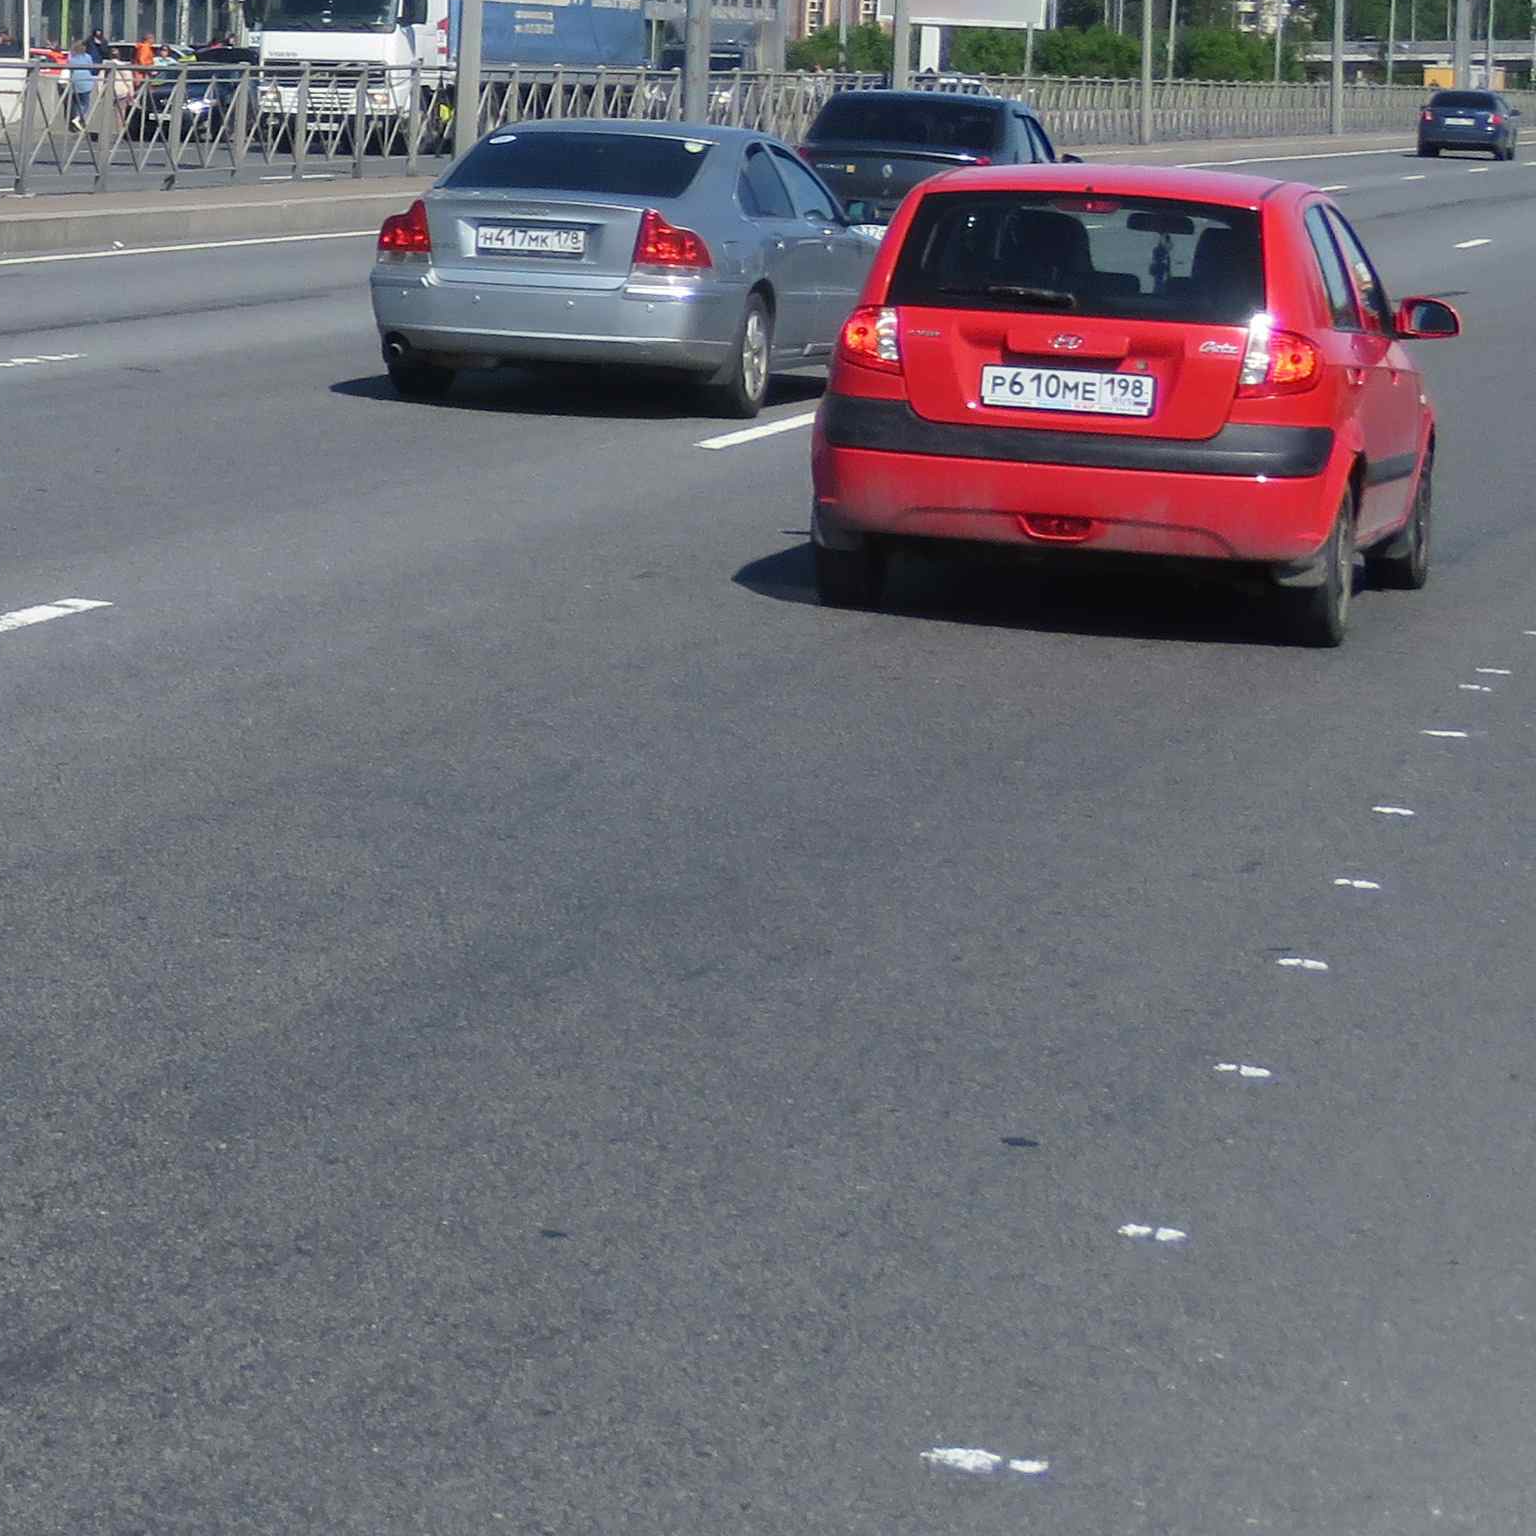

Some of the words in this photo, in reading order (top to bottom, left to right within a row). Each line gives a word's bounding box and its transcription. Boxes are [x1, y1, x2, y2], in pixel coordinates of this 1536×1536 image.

[482, 229, 549, 247] Н417МК
[555, 231, 581, 247] 178
[991, 373, 1097, 402] Р610МЕ
[1103, 377, 1144, 398] 198
